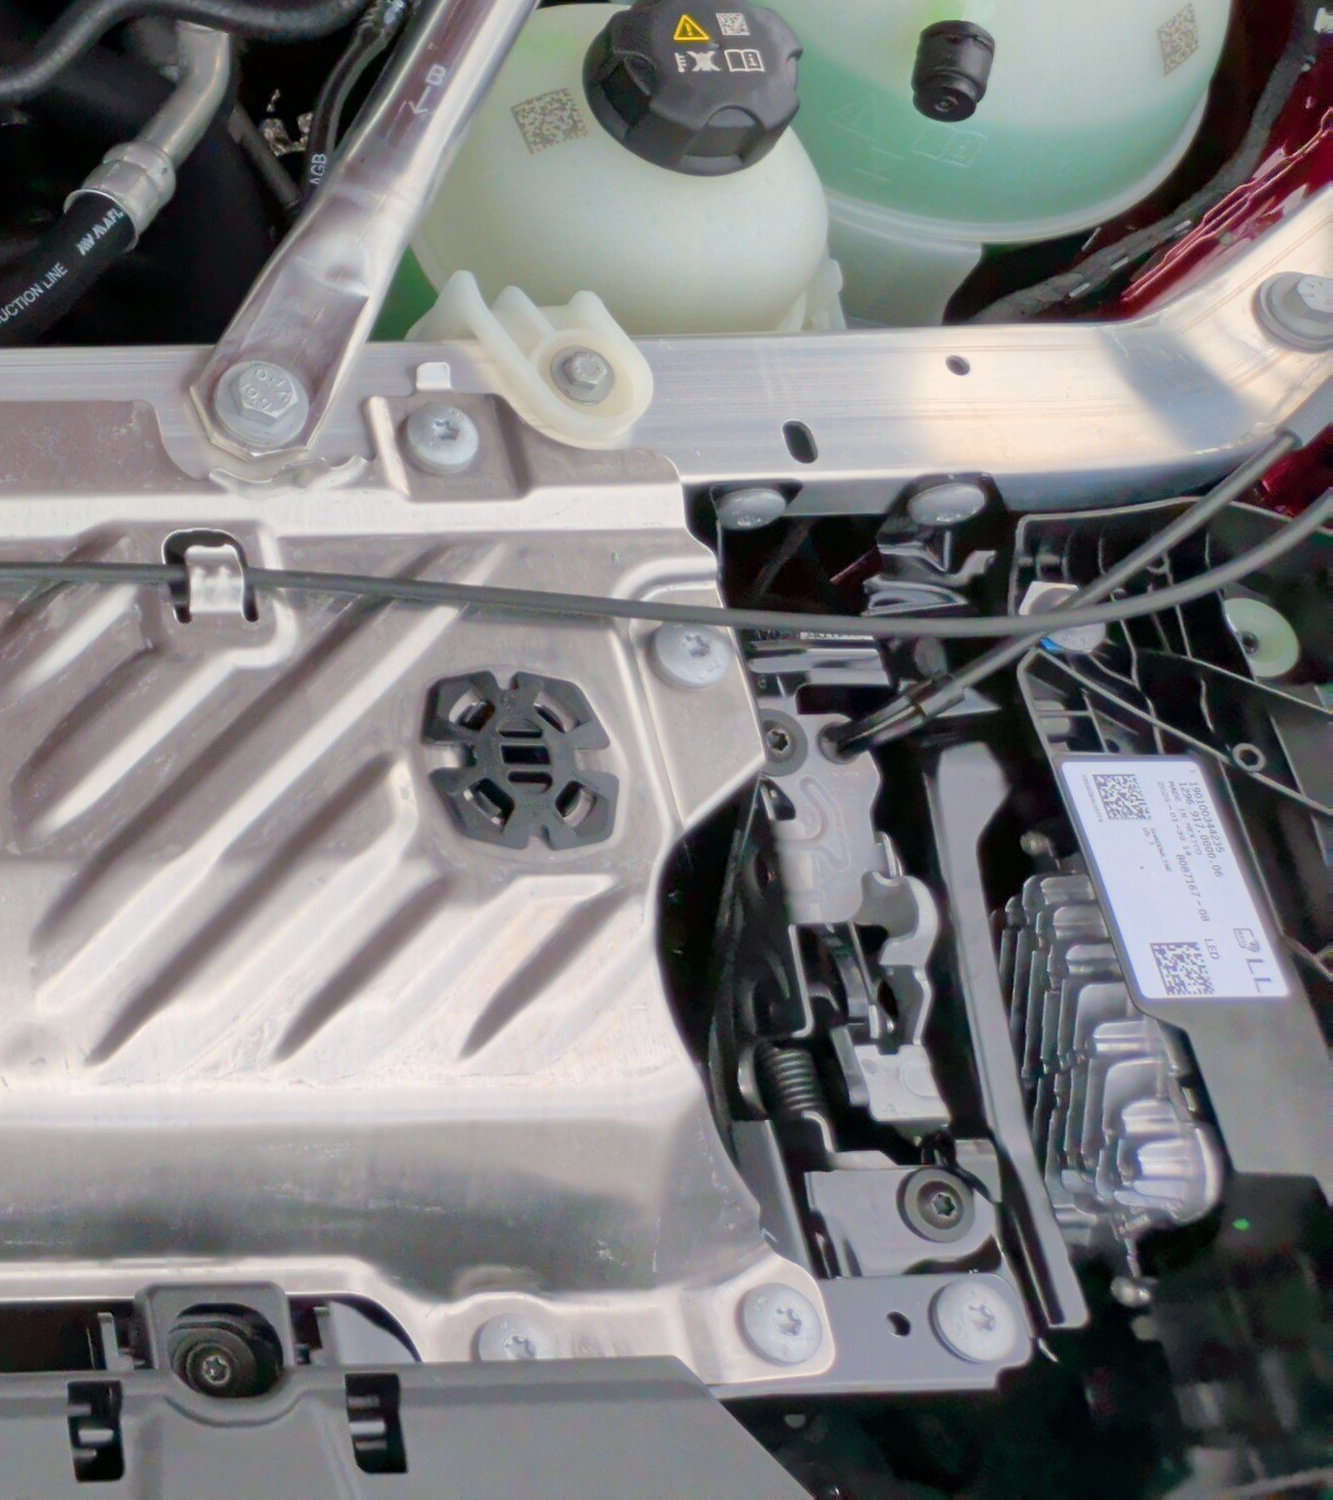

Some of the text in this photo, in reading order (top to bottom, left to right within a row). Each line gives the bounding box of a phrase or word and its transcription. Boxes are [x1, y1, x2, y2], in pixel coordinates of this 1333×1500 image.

[40, 262, 68, 296] LINE
[1177, 781, 1195, 804] 1296
[1203, 938, 1221, 959] LED
